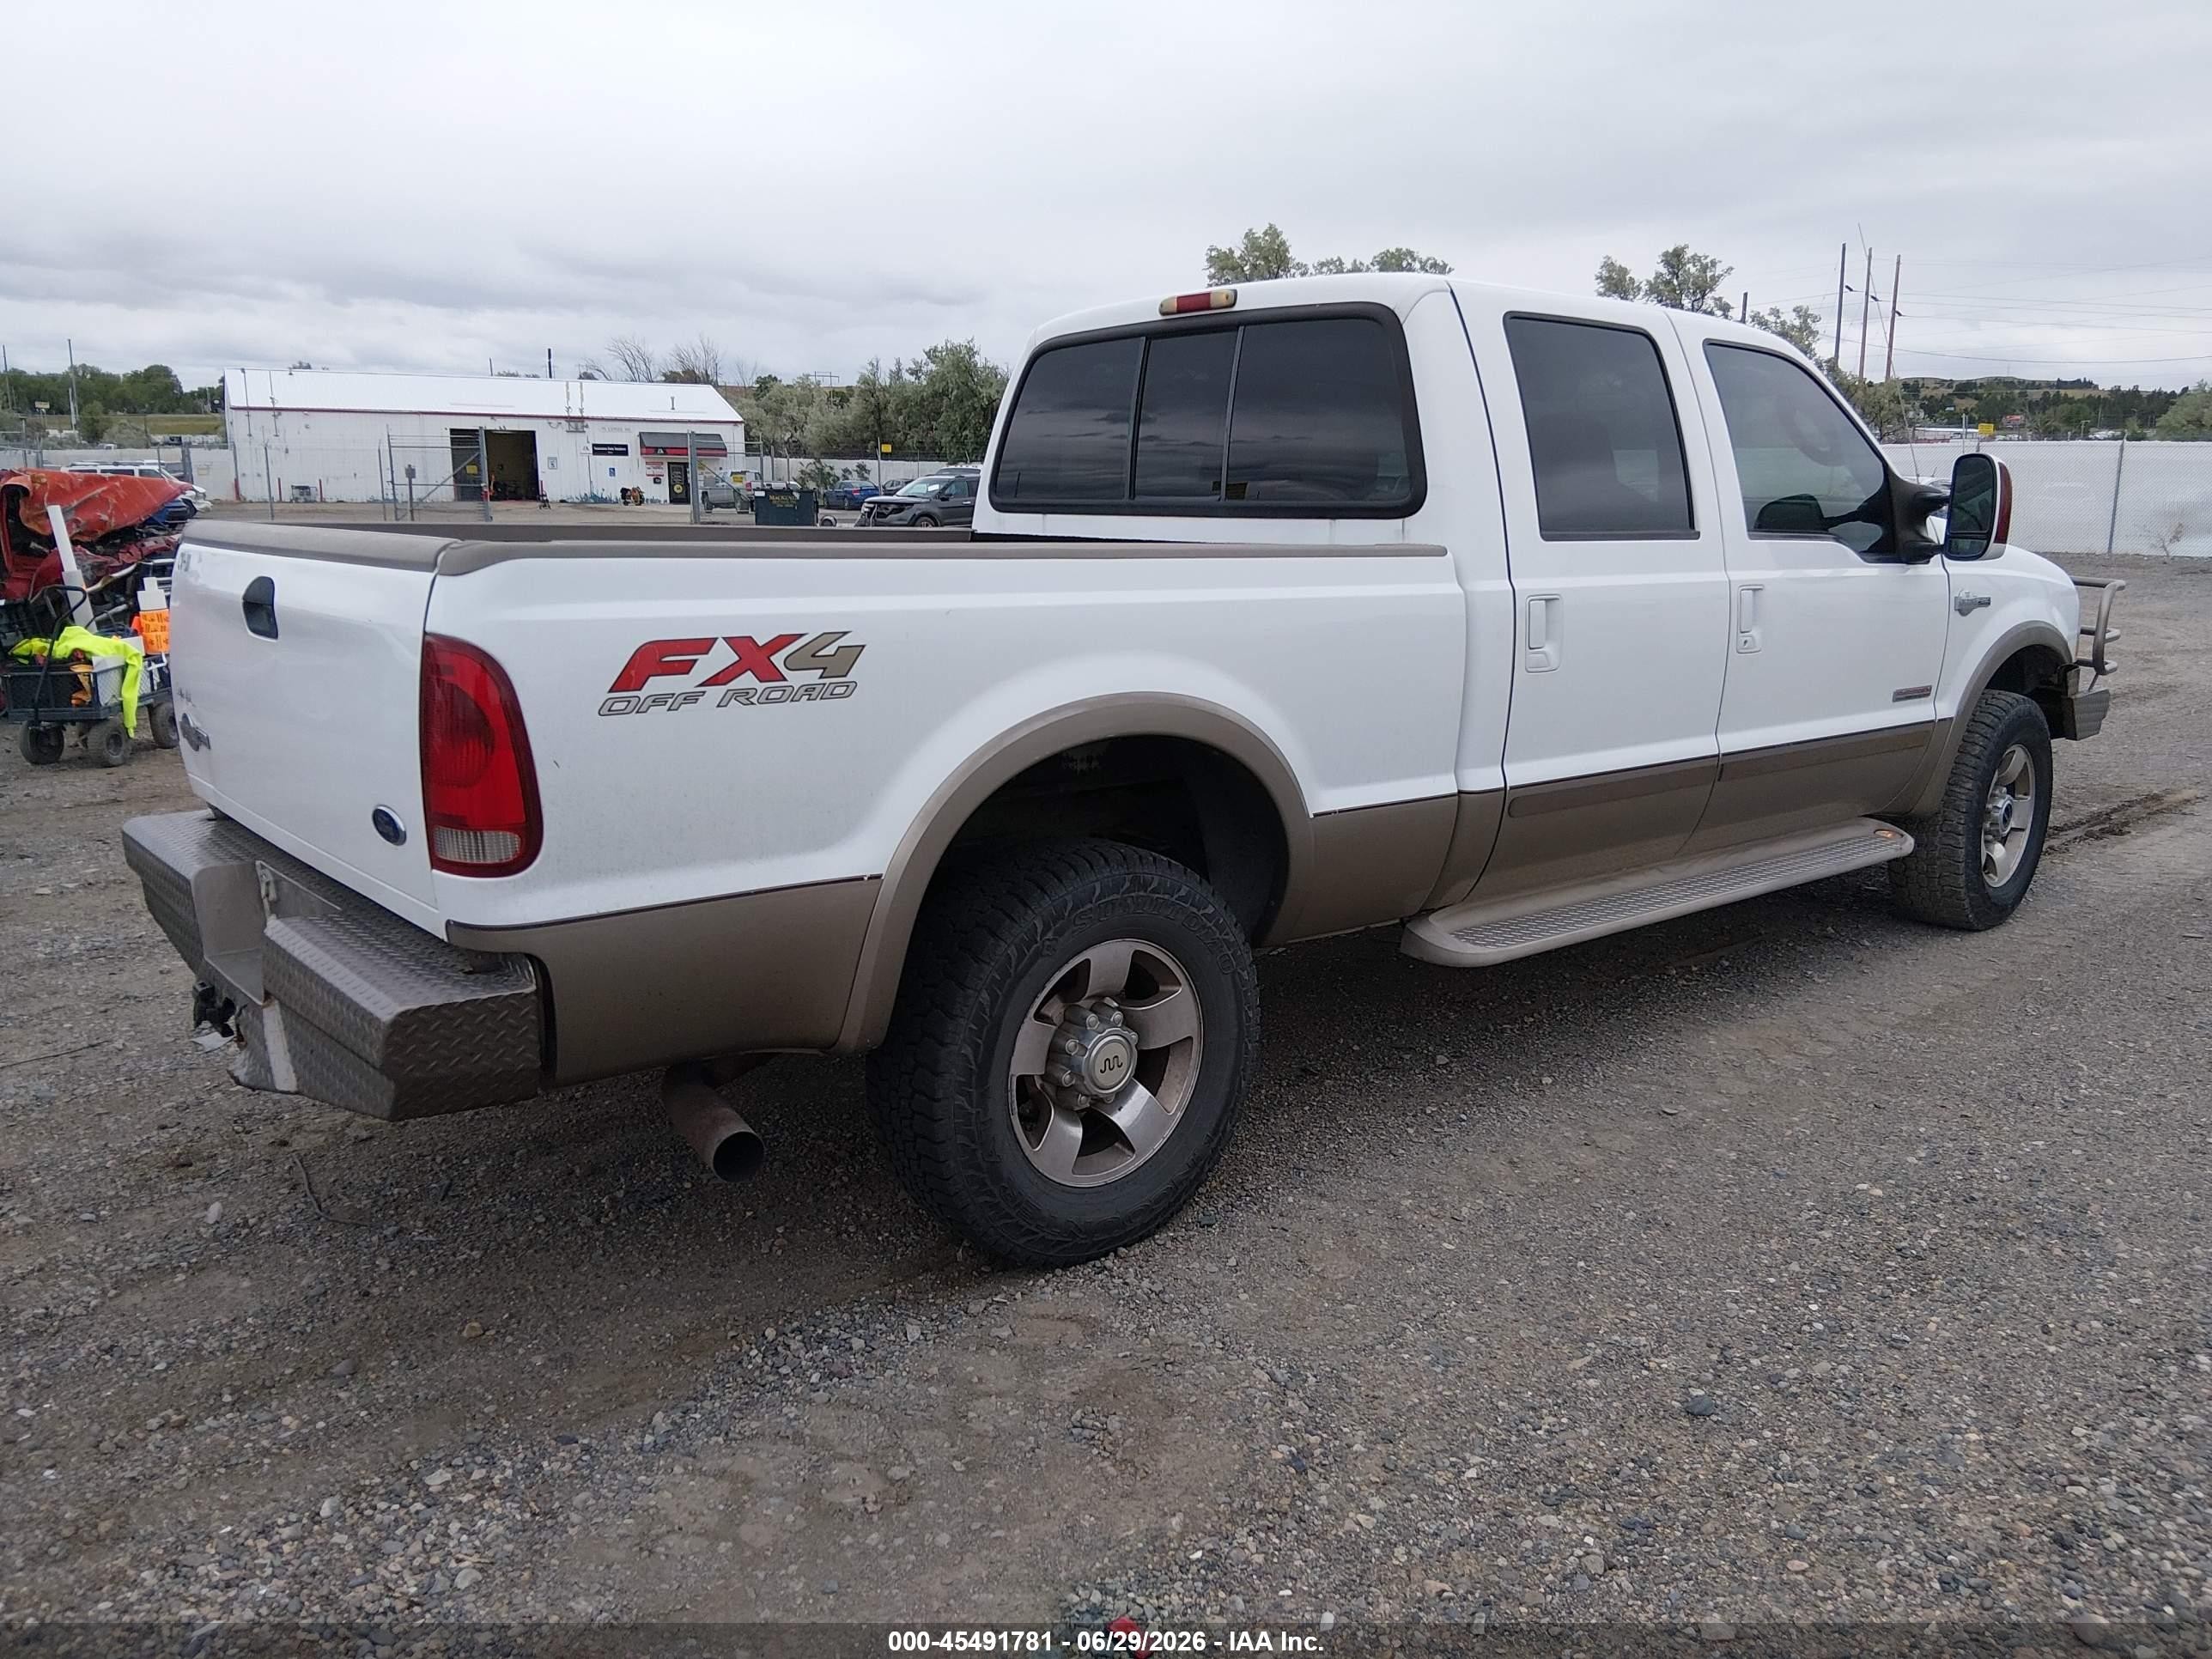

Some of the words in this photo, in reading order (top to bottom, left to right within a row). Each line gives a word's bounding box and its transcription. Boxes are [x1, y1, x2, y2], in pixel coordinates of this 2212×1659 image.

[608, 630, 866, 694] FX4
[598, 690, 707, 717] OFF
[716, 680, 859, 708] ROAD
[1072, 896, 1237, 975] SUMITOMO
